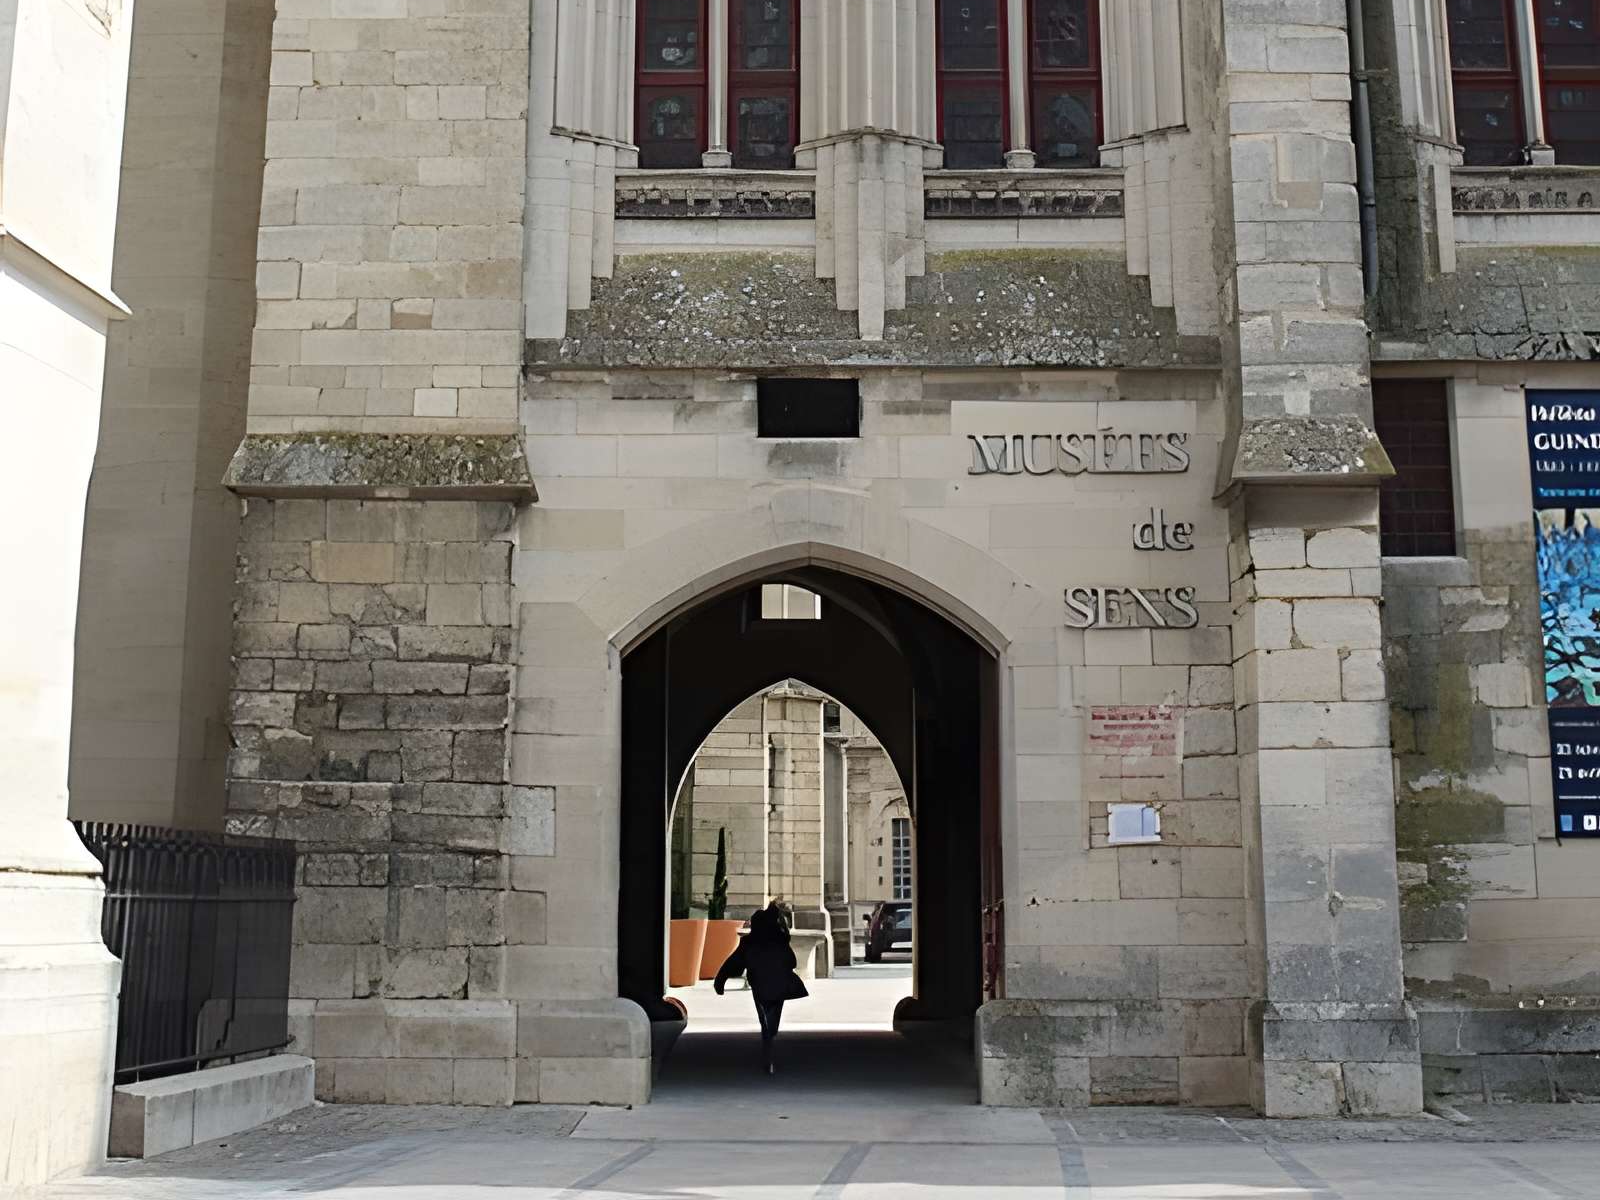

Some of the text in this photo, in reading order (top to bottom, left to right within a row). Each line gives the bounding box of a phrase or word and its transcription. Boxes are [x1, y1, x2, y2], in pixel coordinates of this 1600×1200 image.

[968, 427, 1191, 475] MUSÉES
[1133, 507, 1194, 550] de
[1064, 587, 1199, 629] SENS
